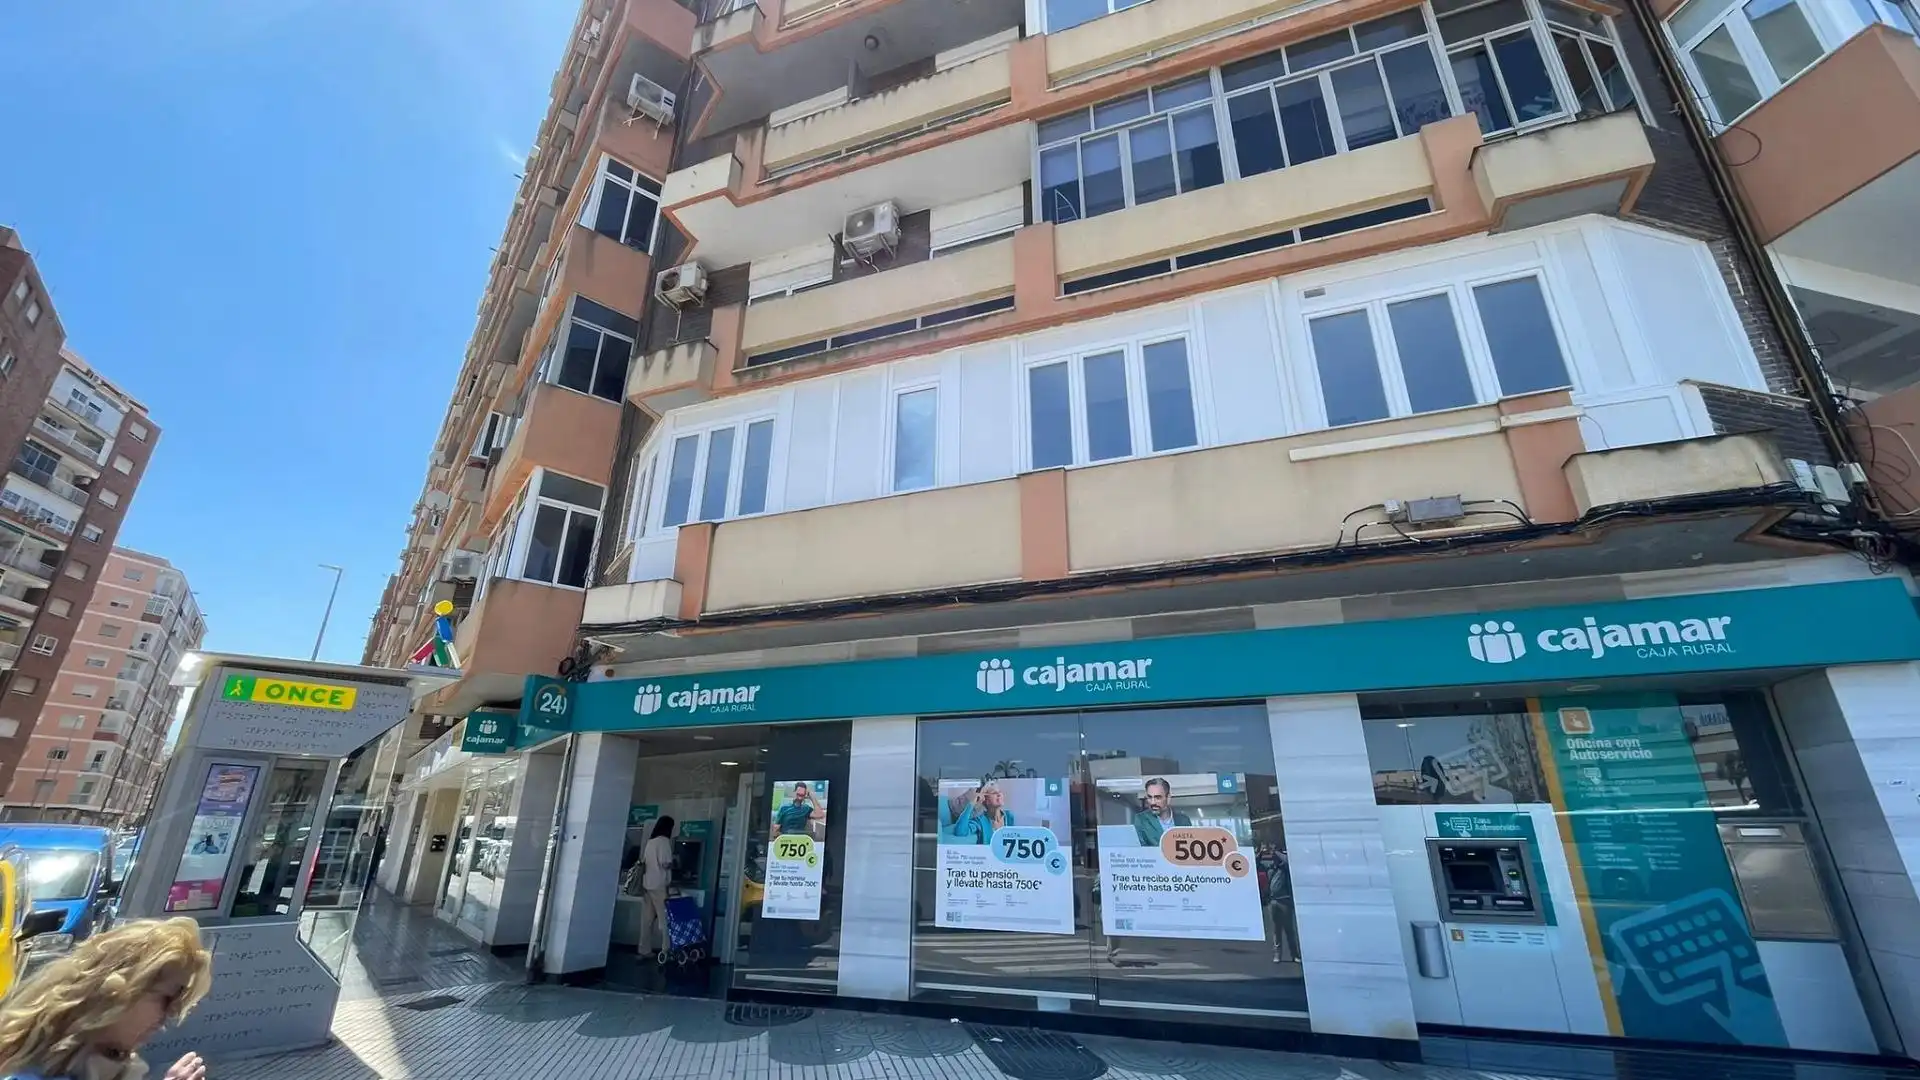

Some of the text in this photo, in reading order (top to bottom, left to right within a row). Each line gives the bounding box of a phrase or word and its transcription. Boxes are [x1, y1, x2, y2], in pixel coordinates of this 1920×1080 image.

[1537, 616, 1731, 659] cajamar
[1637, 642, 1736, 659] CAJA RURAL
[1022, 656, 1153, 692] cajamar
[1086, 680, 1151, 692] CAJA RURAL
[265, 683, 346, 705] ONCE
[667, 682, 761, 714] cajamar
[710, 703, 756, 714] CAJA RURAL
[466, 735, 505, 745] cajamar
[1566, 738, 1641, 749] Oficina con
[1569, 748, 1653, 760] Autoservicio
[1051, 858, 1060, 869] €
[1231, 860, 1242, 871] €
[946, 868, 1018, 880] Trae tu pensión
[1111, 874, 1231, 884] Trae tu recibo de Autónomo
[946, 880, 951, 889] y
[954, 879, 984, 888] llévate
[986, 879, 1013, 889] hasta
[1112, 885, 1117, 893] y
[1119, 883, 1146, 891] llévate
[1148, 884, 1172, 892] hasta
